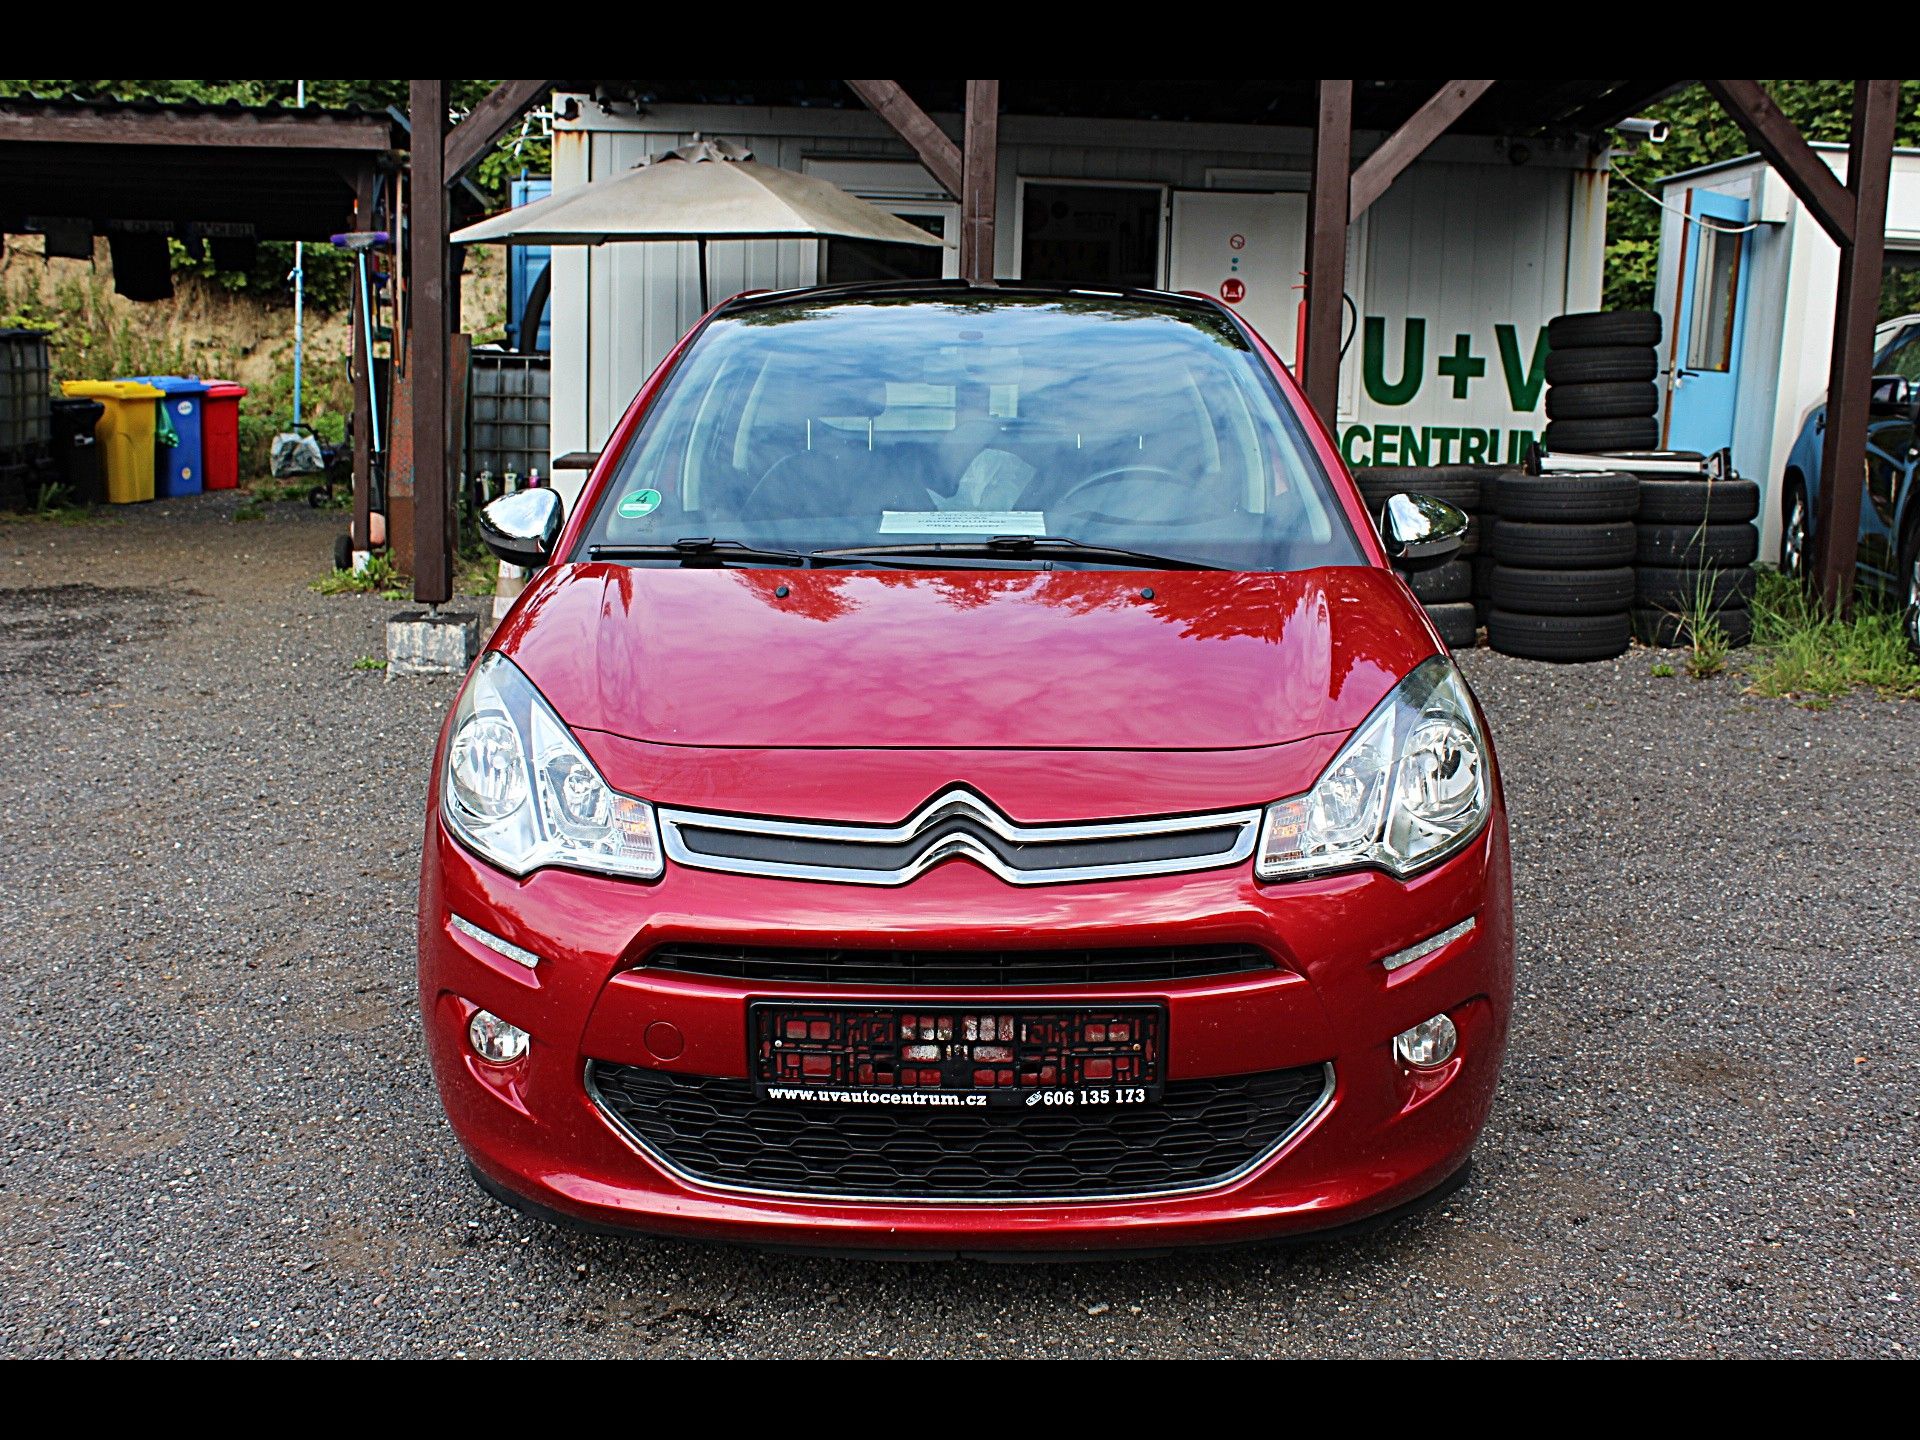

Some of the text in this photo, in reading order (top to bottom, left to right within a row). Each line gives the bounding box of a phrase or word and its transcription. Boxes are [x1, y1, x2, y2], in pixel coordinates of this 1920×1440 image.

[1363, 316, 1550, 413] U+V
[635, 490, 649, 504] 4
[768, 1087, 1146, 1106] www.uvautocentrum.cz 606 135 173
